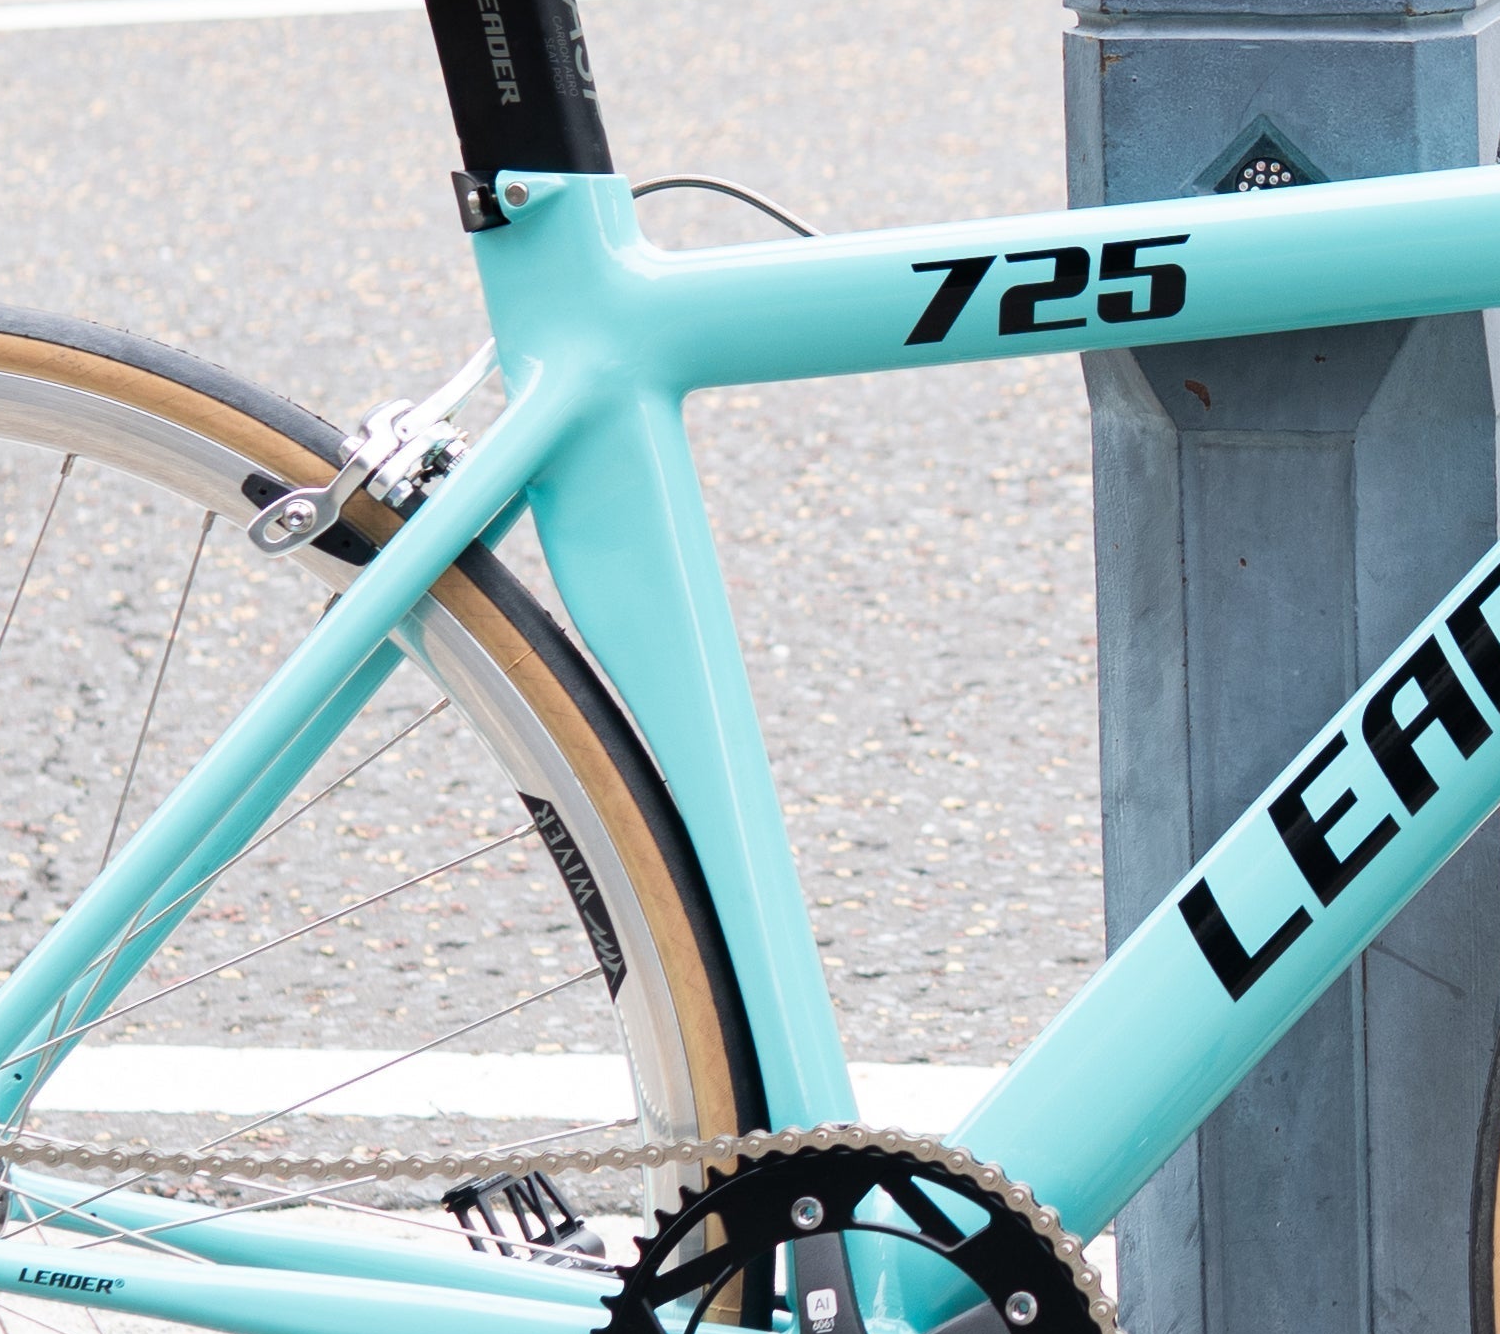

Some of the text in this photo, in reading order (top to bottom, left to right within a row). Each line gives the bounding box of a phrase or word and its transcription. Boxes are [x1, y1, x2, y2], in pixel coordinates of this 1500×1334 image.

[545, 37, 567, 96] SEAT POST
[551, 15, 579, 98] CARBON AERO
[905, 234, 1192, 346] 725
[535, 802, 598, 905] WIVER
[812, 1317, 835, 1331] 6061
